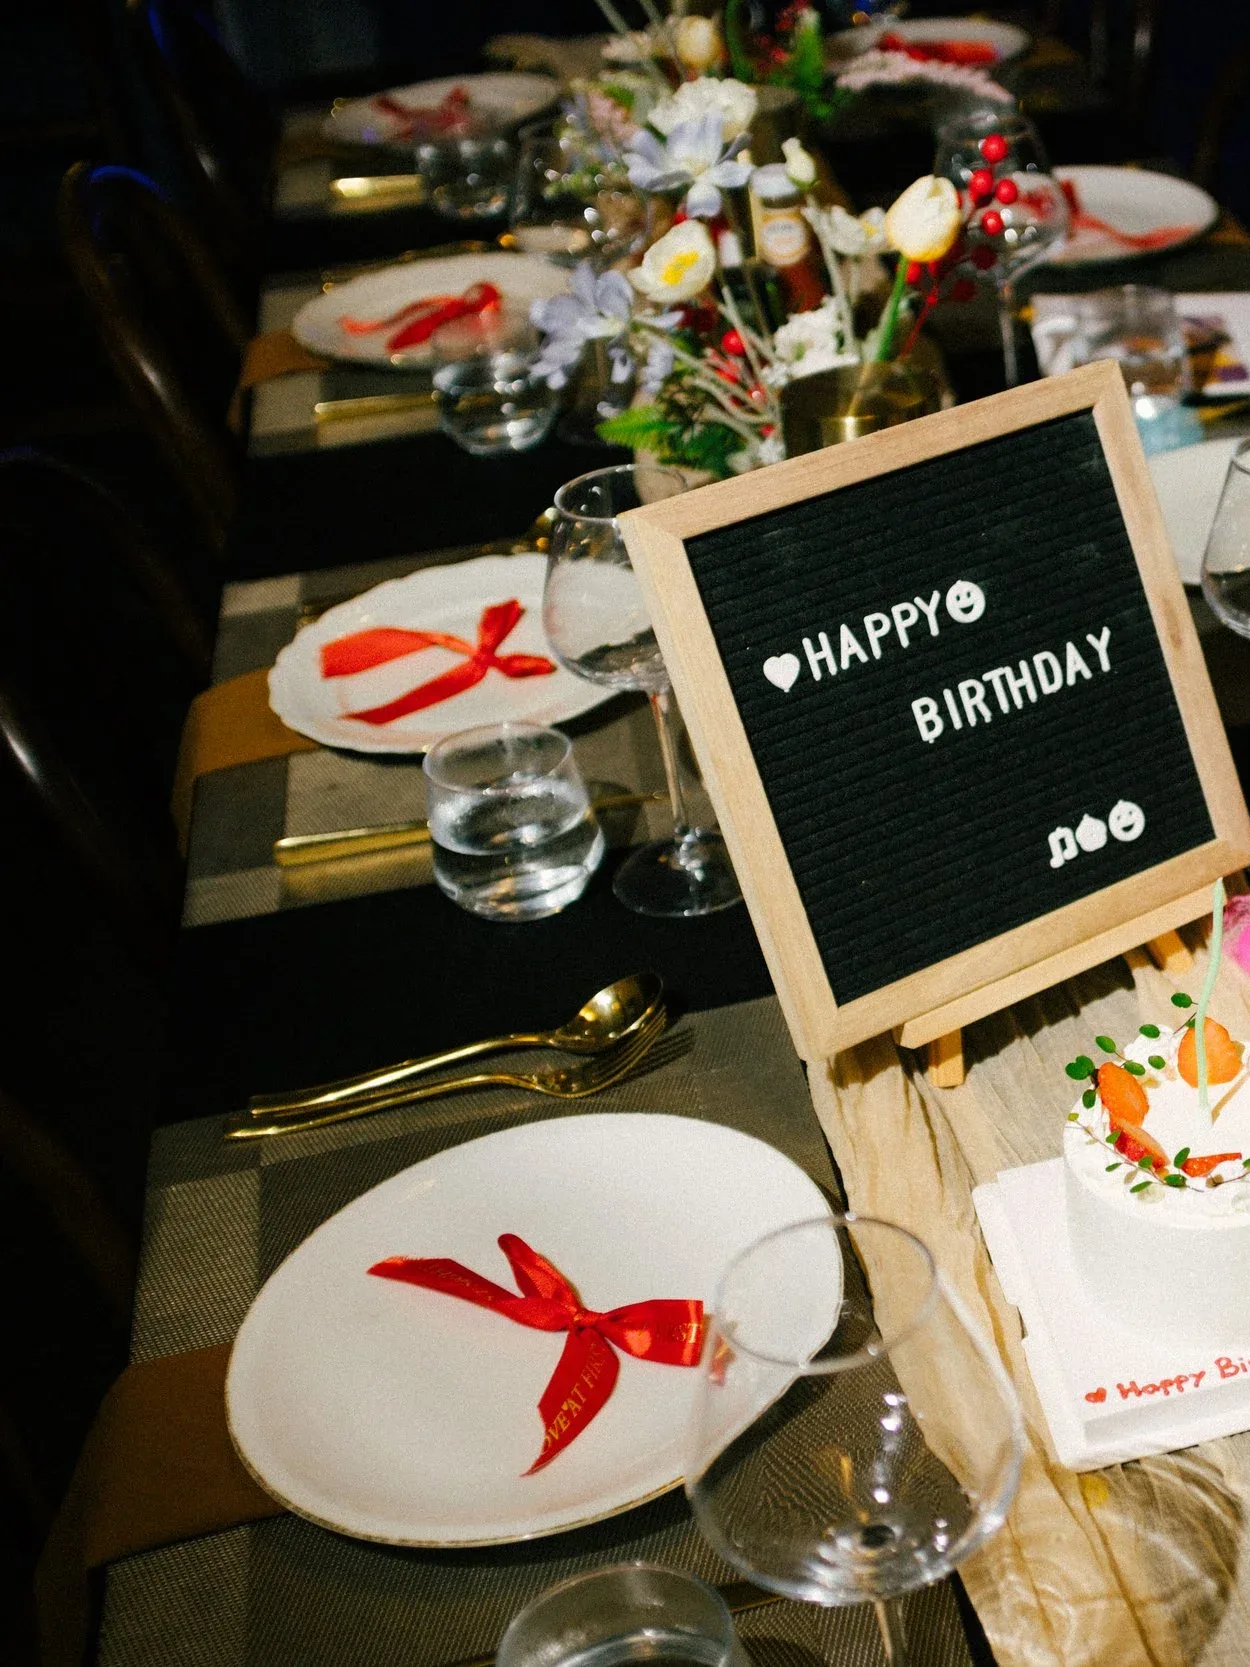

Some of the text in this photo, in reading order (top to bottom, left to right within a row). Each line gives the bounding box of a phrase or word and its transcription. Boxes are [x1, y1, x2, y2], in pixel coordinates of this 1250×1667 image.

[802, 590, 941, 682] HAPPY
[911, 626, 1111, 744] BIRTHDAY
[1116, 1370, 1206, 1400] Happy
